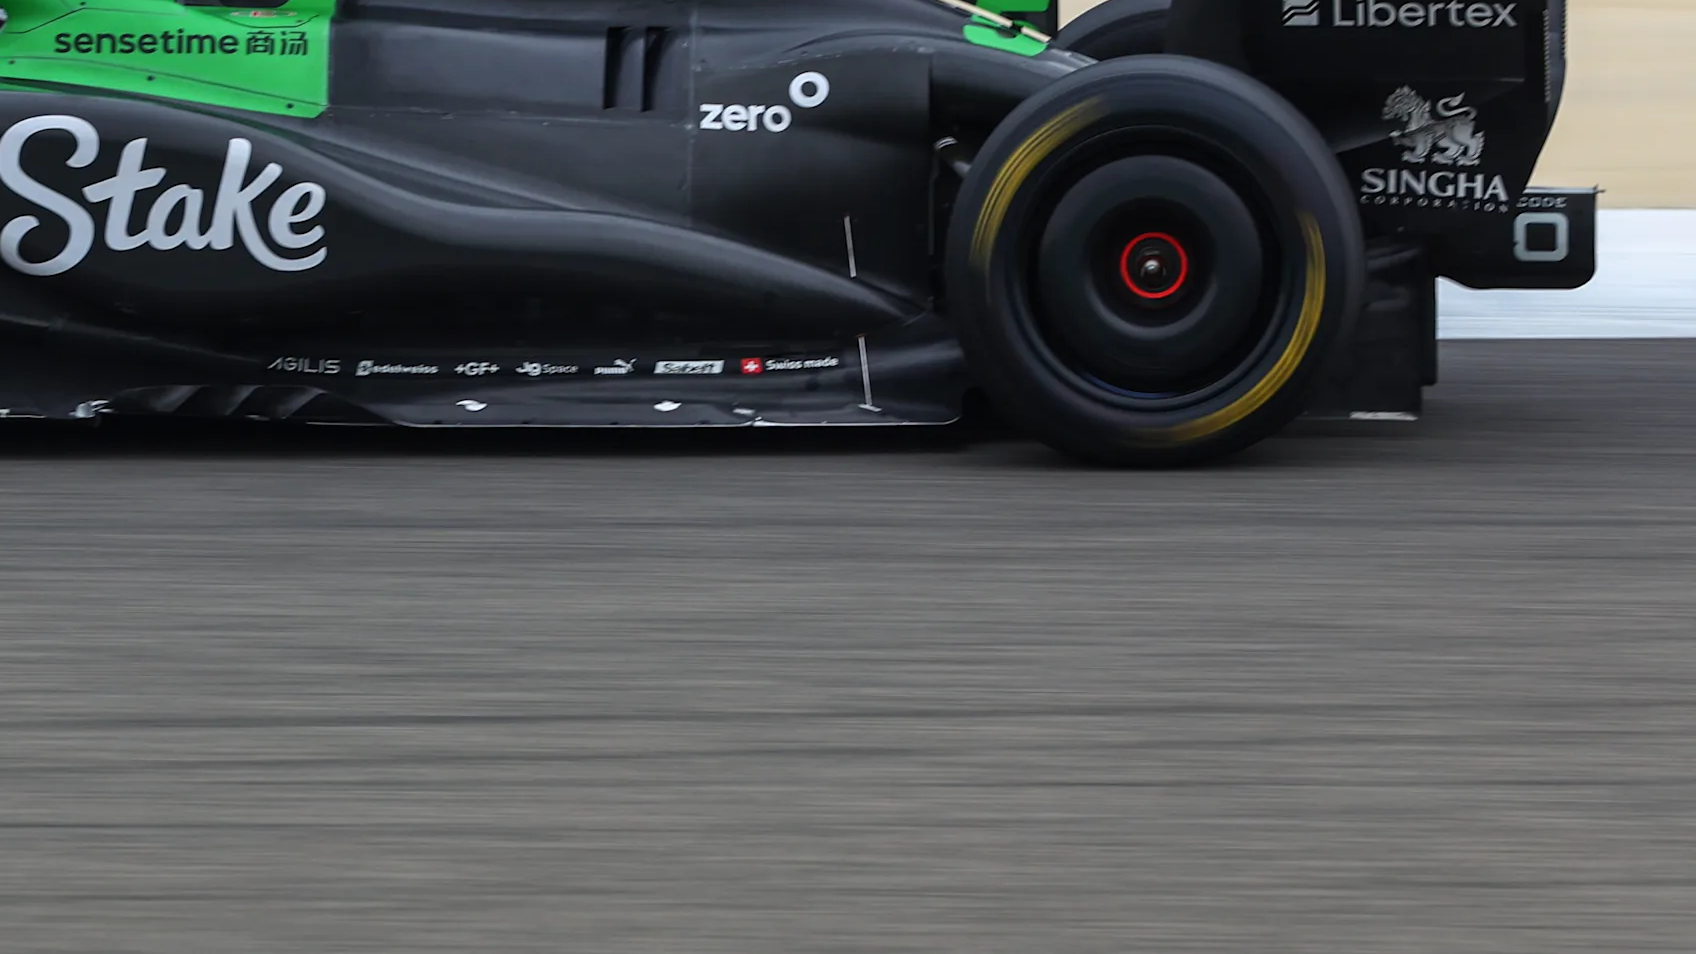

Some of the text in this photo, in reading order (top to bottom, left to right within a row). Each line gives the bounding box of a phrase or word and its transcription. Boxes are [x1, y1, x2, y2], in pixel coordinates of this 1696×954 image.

[54, 29, 309, 56] sensetime 商汤
[699, 103, 792, 133] zero
[1360, 167, 1510, 202] SINGHA
[267, 356, 342, 375] AGILIS
[765, 356, 839, 371] Swiss made
